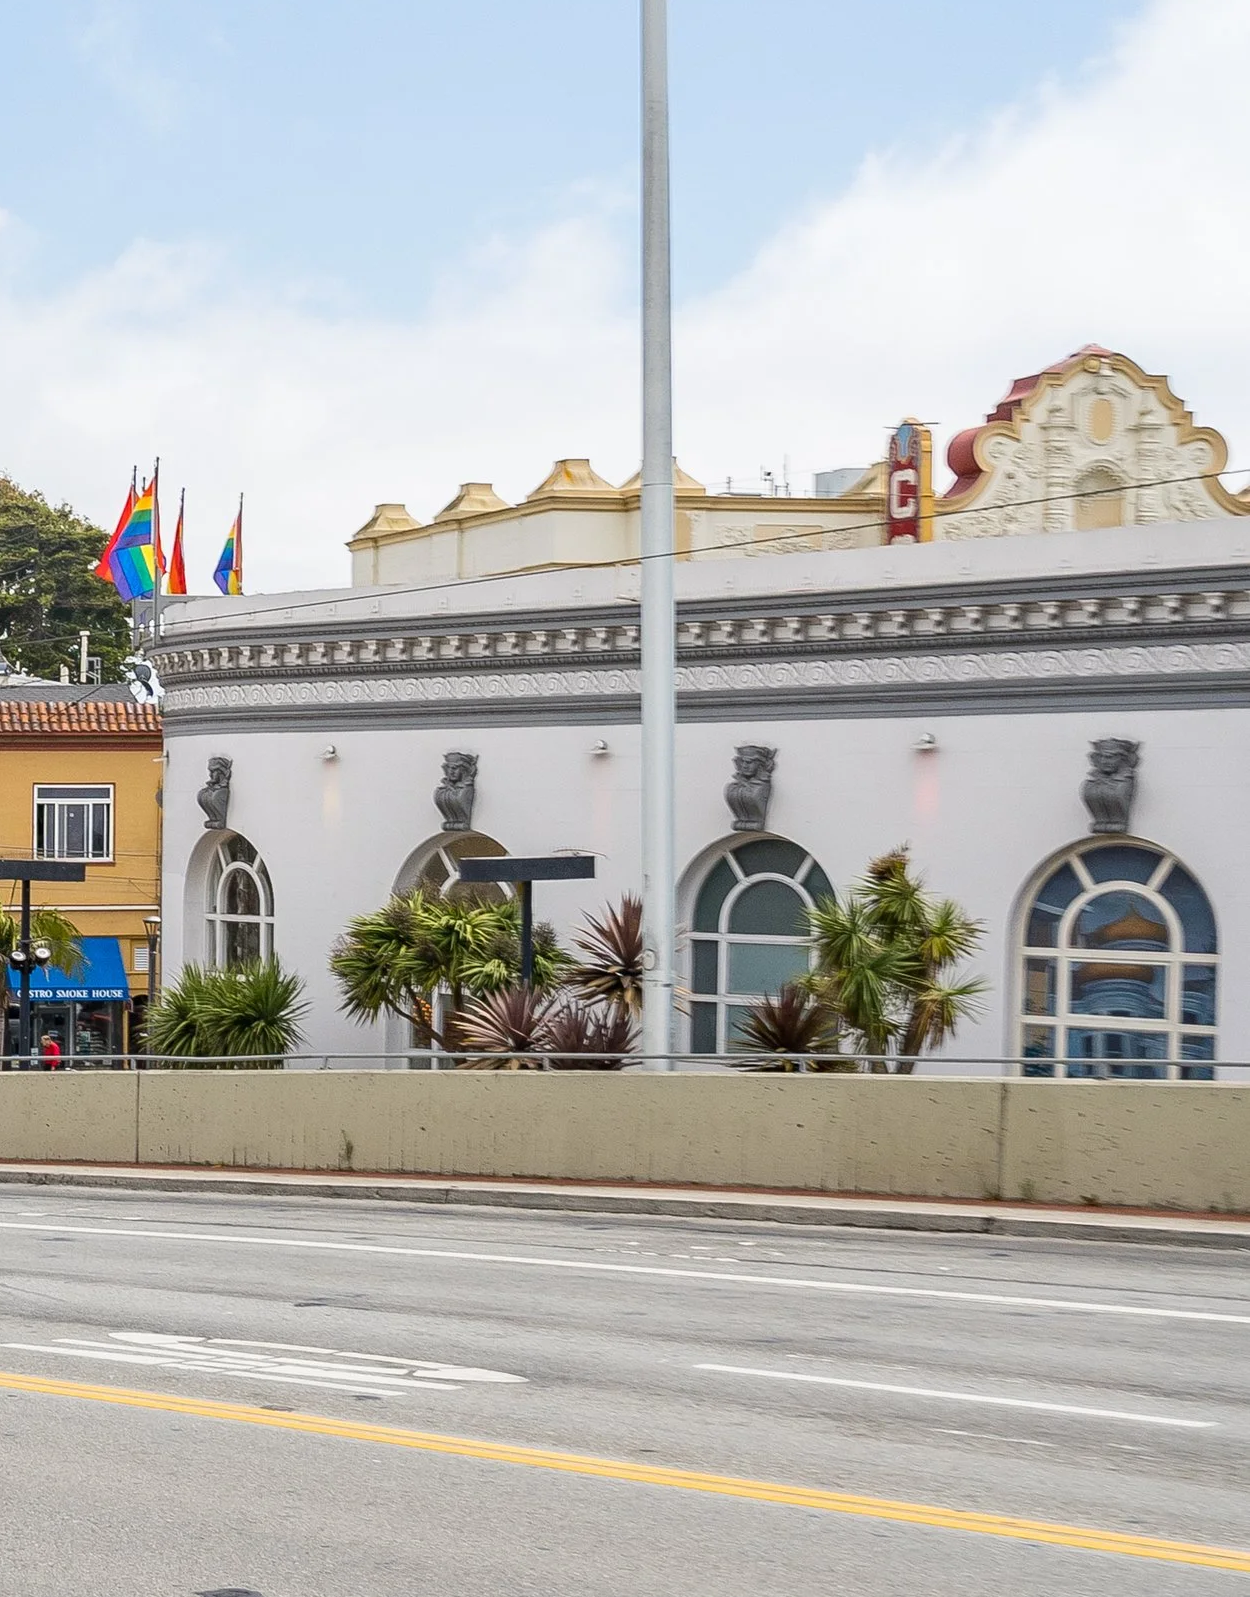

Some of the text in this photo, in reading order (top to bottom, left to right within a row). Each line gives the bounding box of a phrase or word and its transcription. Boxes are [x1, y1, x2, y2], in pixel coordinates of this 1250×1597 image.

[890, 469, 918, 542] C
[17, 989, 123, 998] CSTRO SMOKE HOUSE
